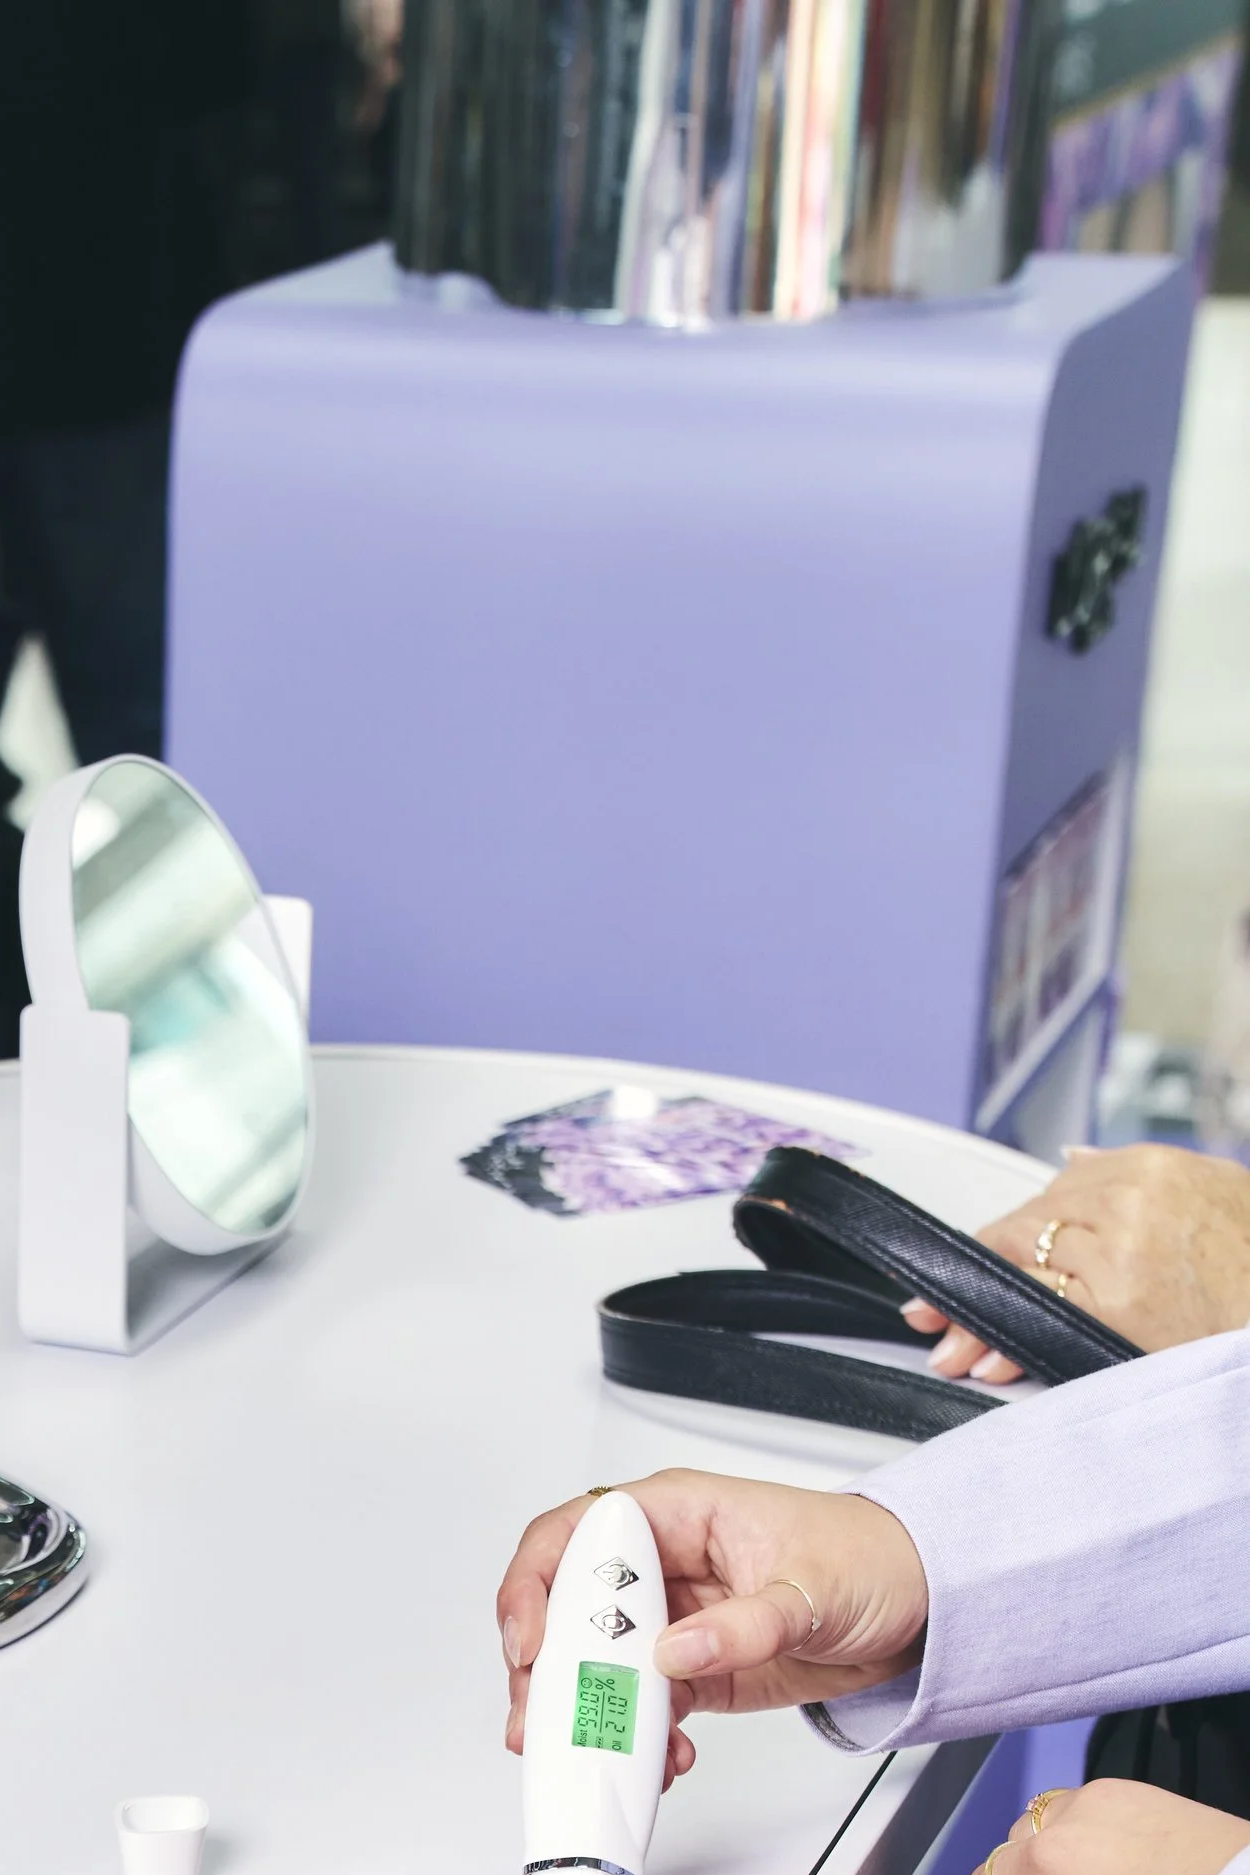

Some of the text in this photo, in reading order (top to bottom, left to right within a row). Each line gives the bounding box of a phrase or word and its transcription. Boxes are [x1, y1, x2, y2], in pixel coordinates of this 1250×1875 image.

[595, 1677, 615, 1691] %
[605, 1695, 628, 1751] Oil 21.0
